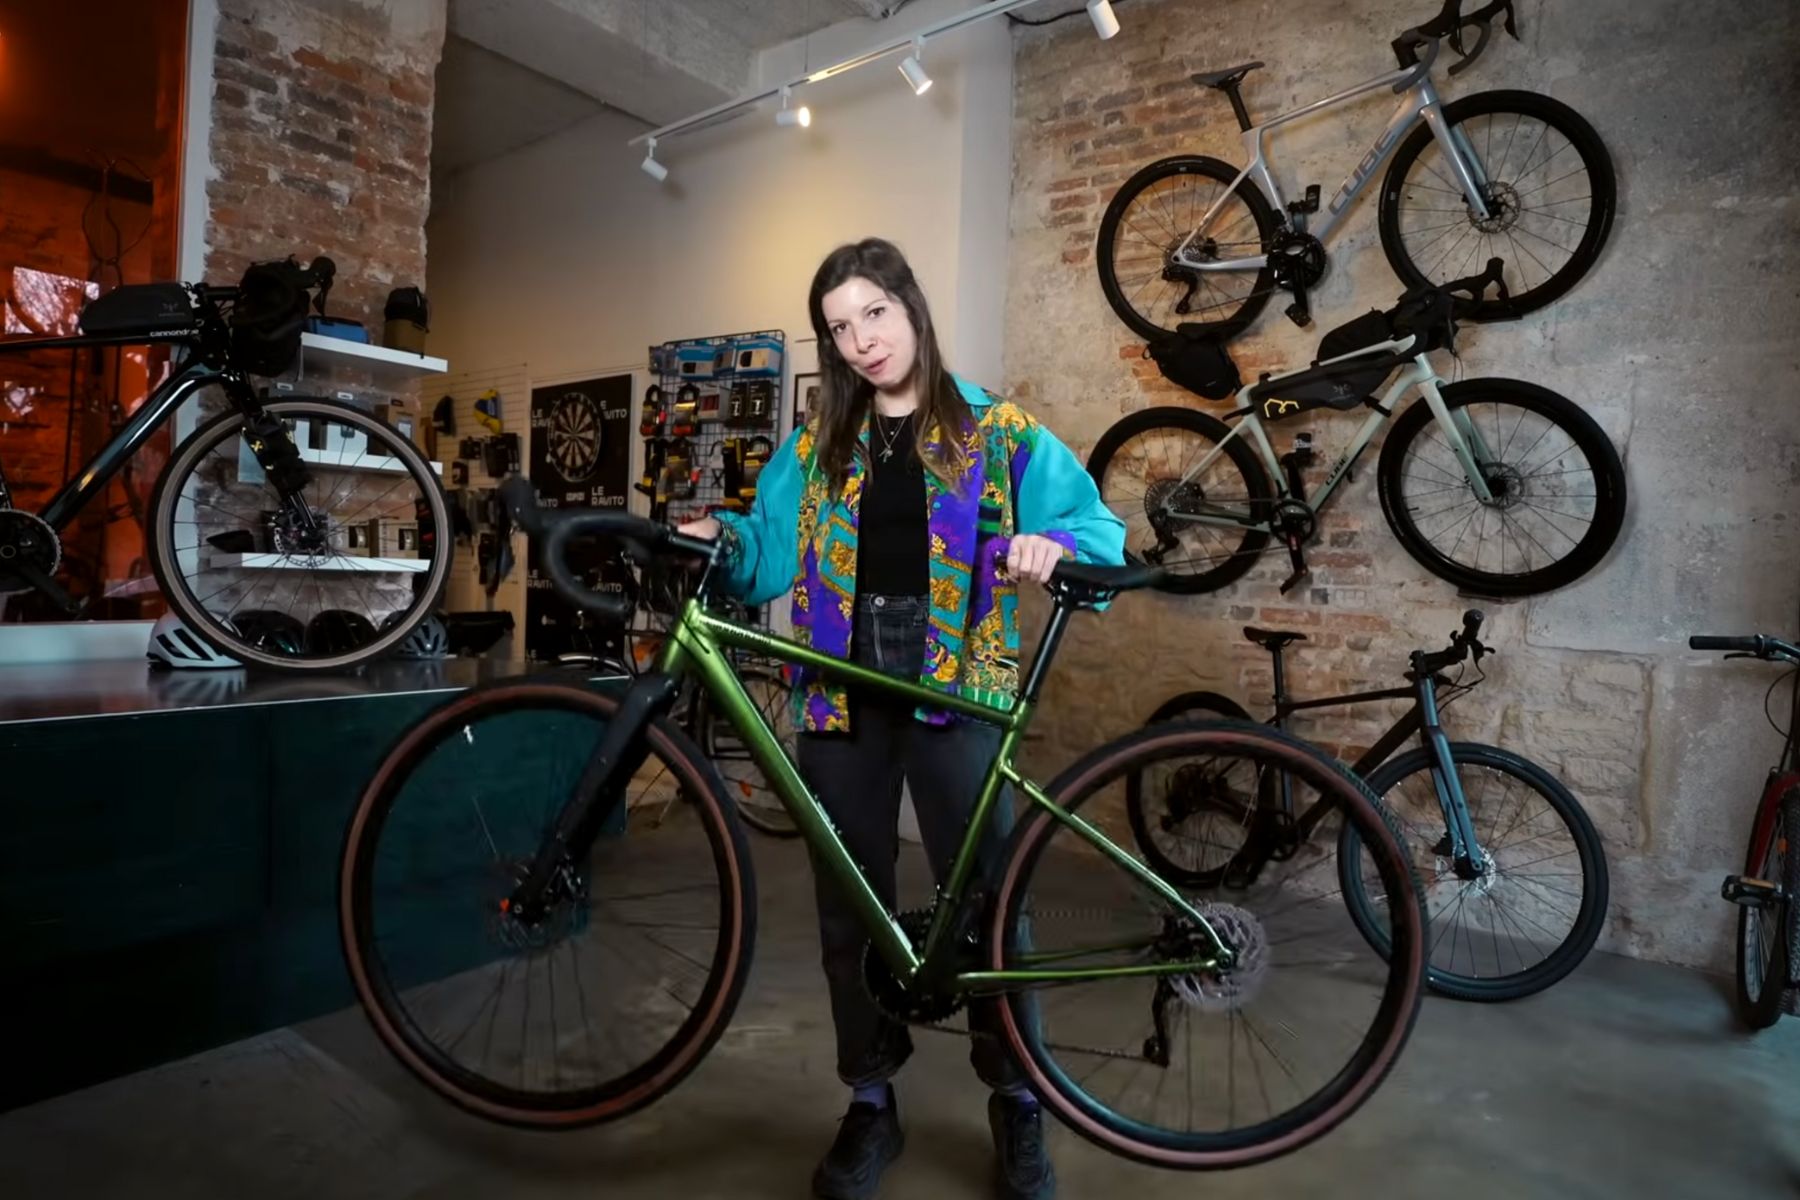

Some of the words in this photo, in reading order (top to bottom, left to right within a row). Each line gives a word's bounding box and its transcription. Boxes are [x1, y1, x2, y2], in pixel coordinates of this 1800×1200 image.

[1328, 127, 1396, 216] CUBE
[592, 486, 604, 496] LE
[591, 496, 625, 506] RAVITO
[527, 579, 553, 590] RAVIT
